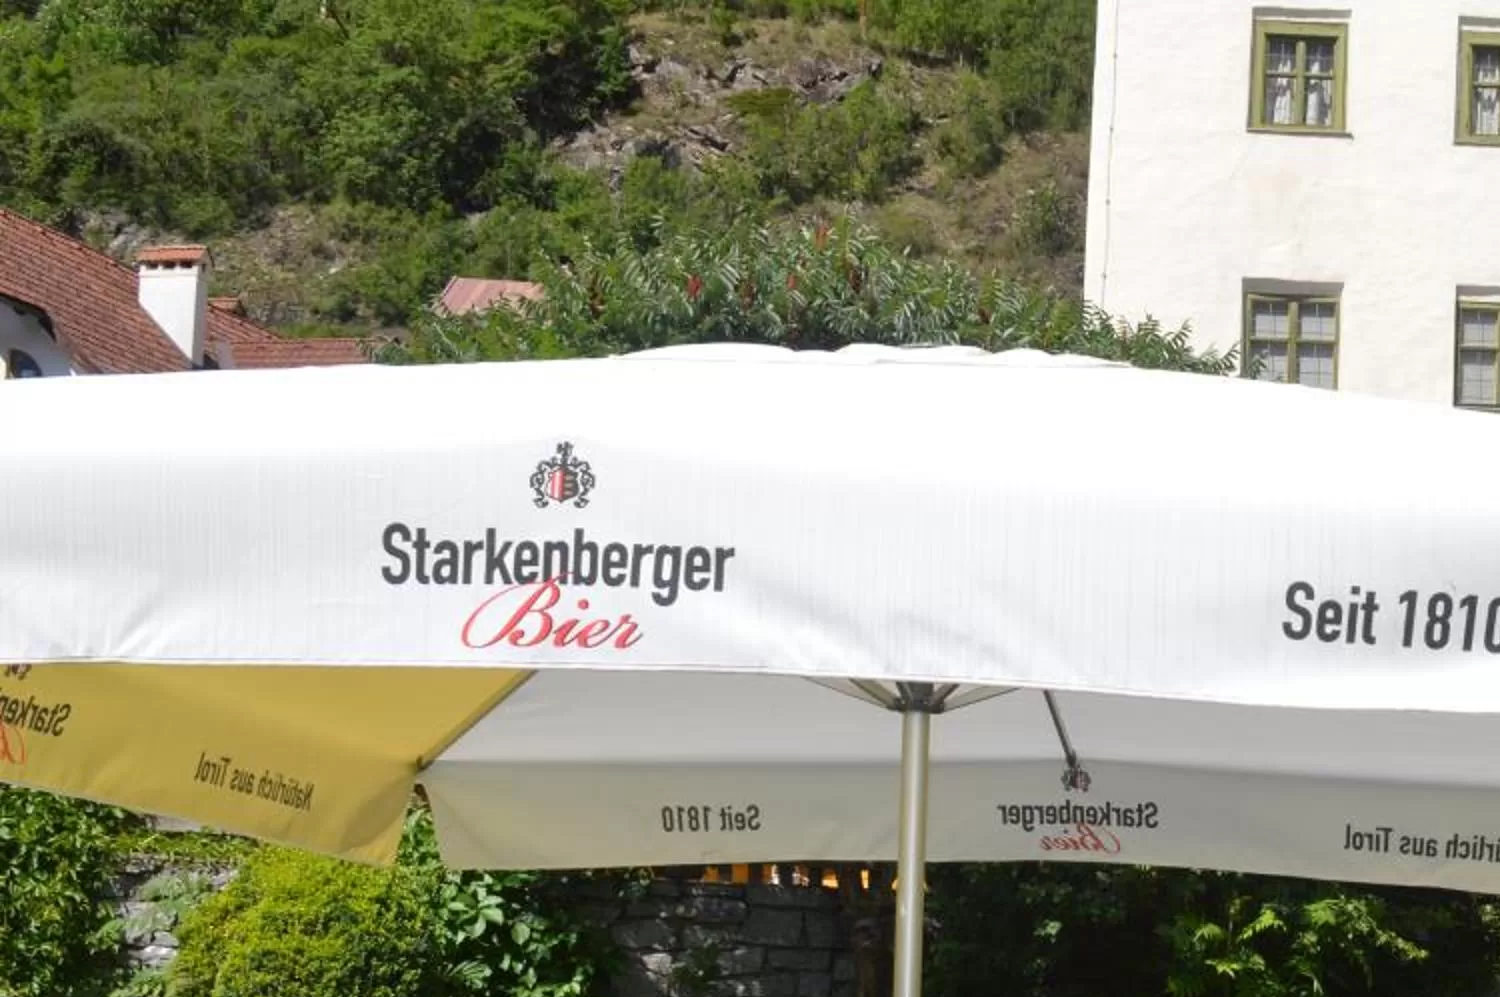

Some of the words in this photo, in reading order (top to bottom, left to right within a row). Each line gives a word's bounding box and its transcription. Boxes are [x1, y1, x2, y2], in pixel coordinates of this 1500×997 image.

[381, 522, 735, 606] Starkenberger
[460, 570, 643, 649] Bier
[1282, 581, 1380, 645] Seit
